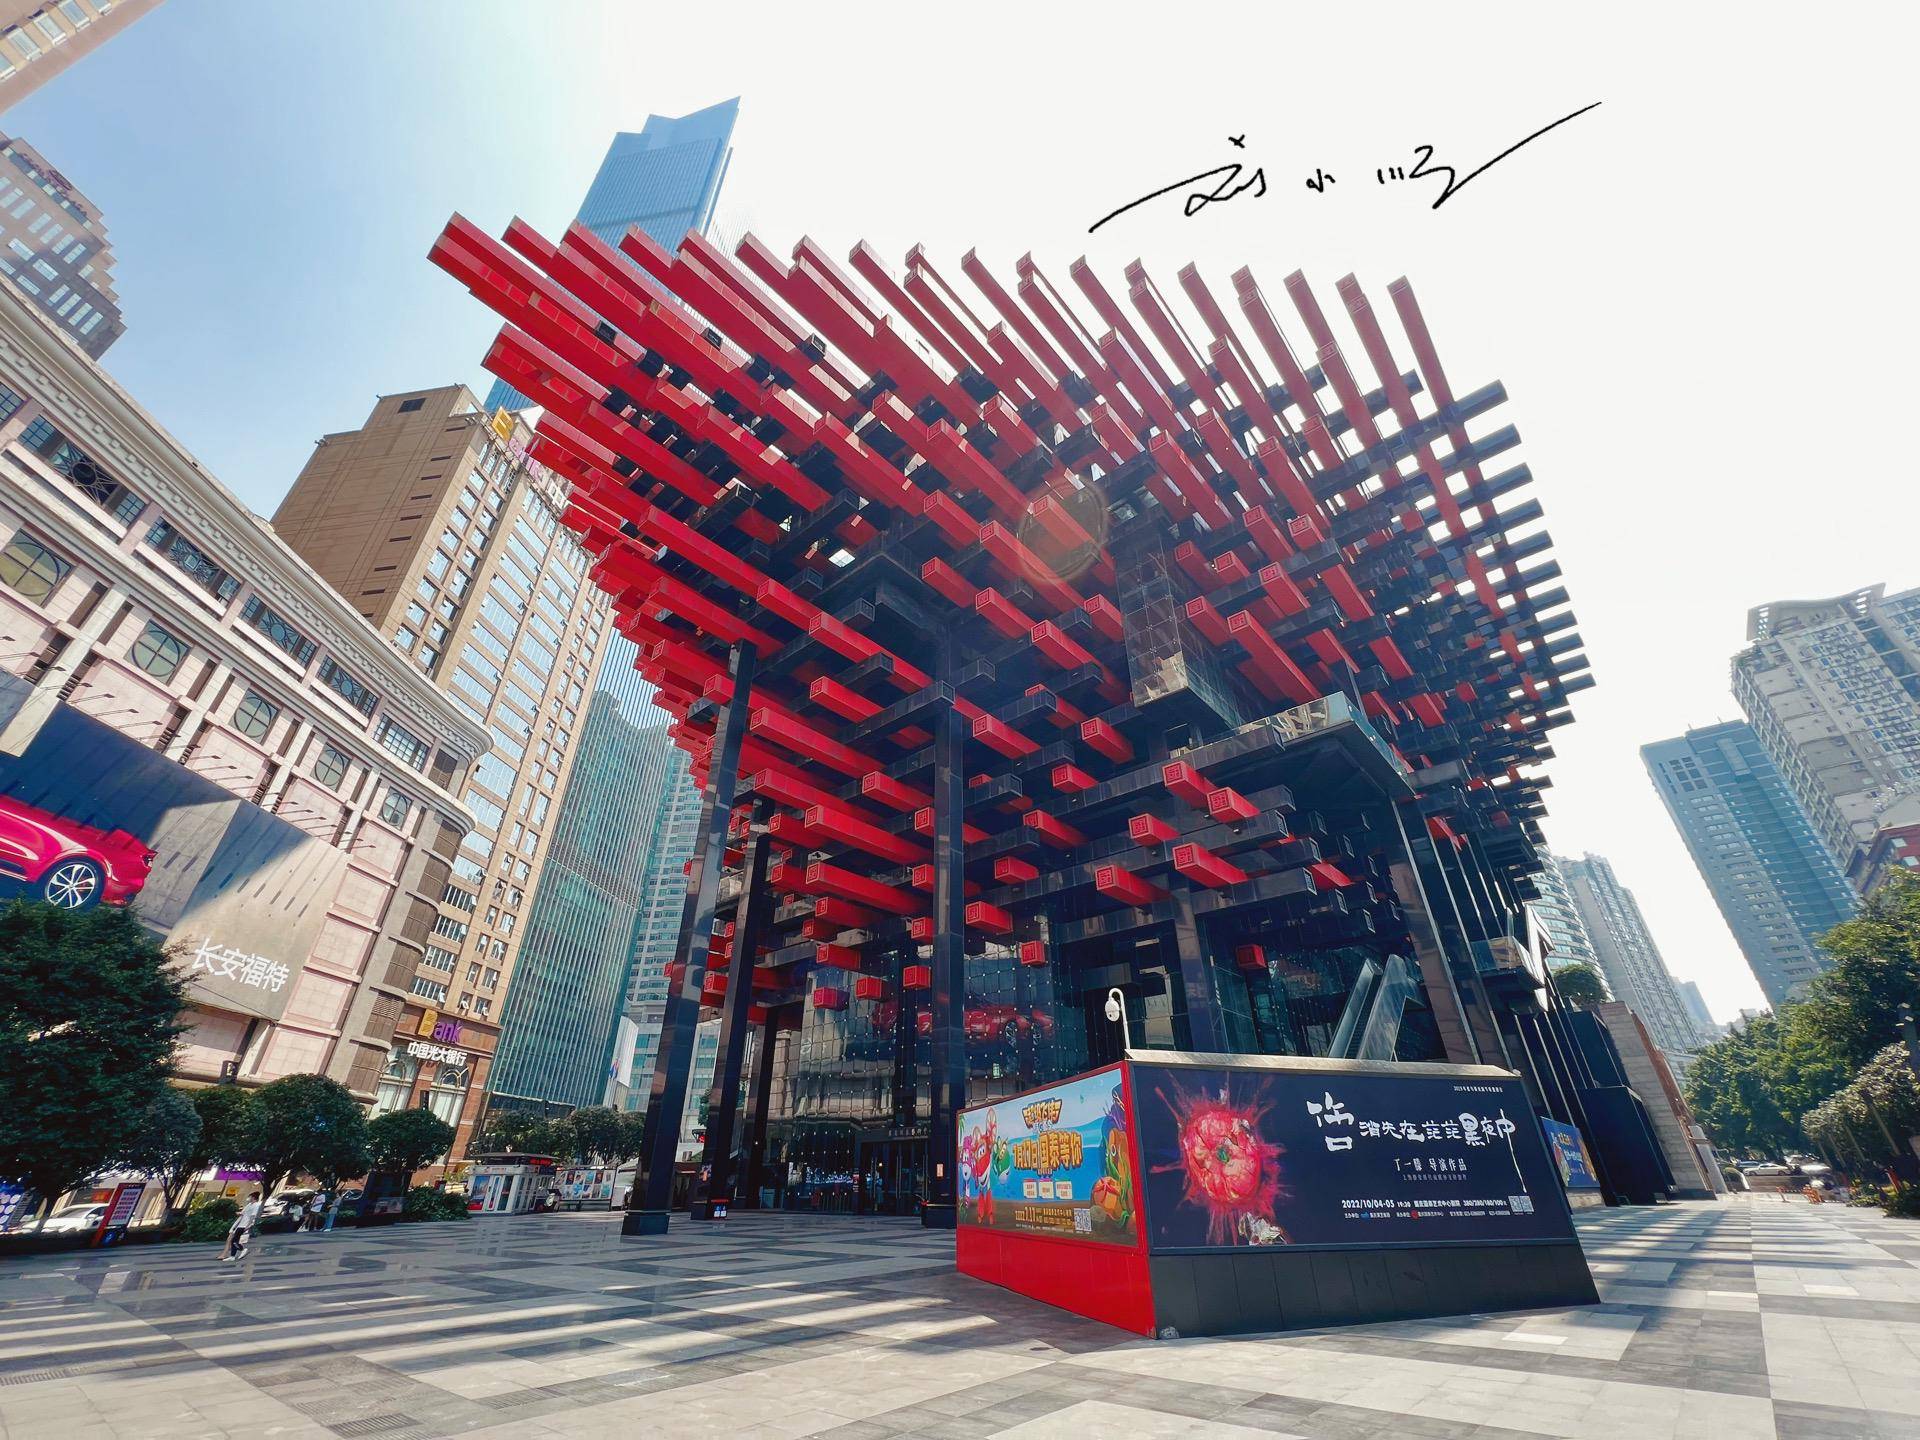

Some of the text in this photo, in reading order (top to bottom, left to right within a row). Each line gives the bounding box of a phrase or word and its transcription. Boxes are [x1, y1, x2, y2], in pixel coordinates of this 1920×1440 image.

[192, 937, 289, 992] 长安福特
[417, 1008, 464, 1044] Bank
[407, 1042, 468, 1066] 中国光大银行
[1428, 1158, 1468, 1171] 导演作品
